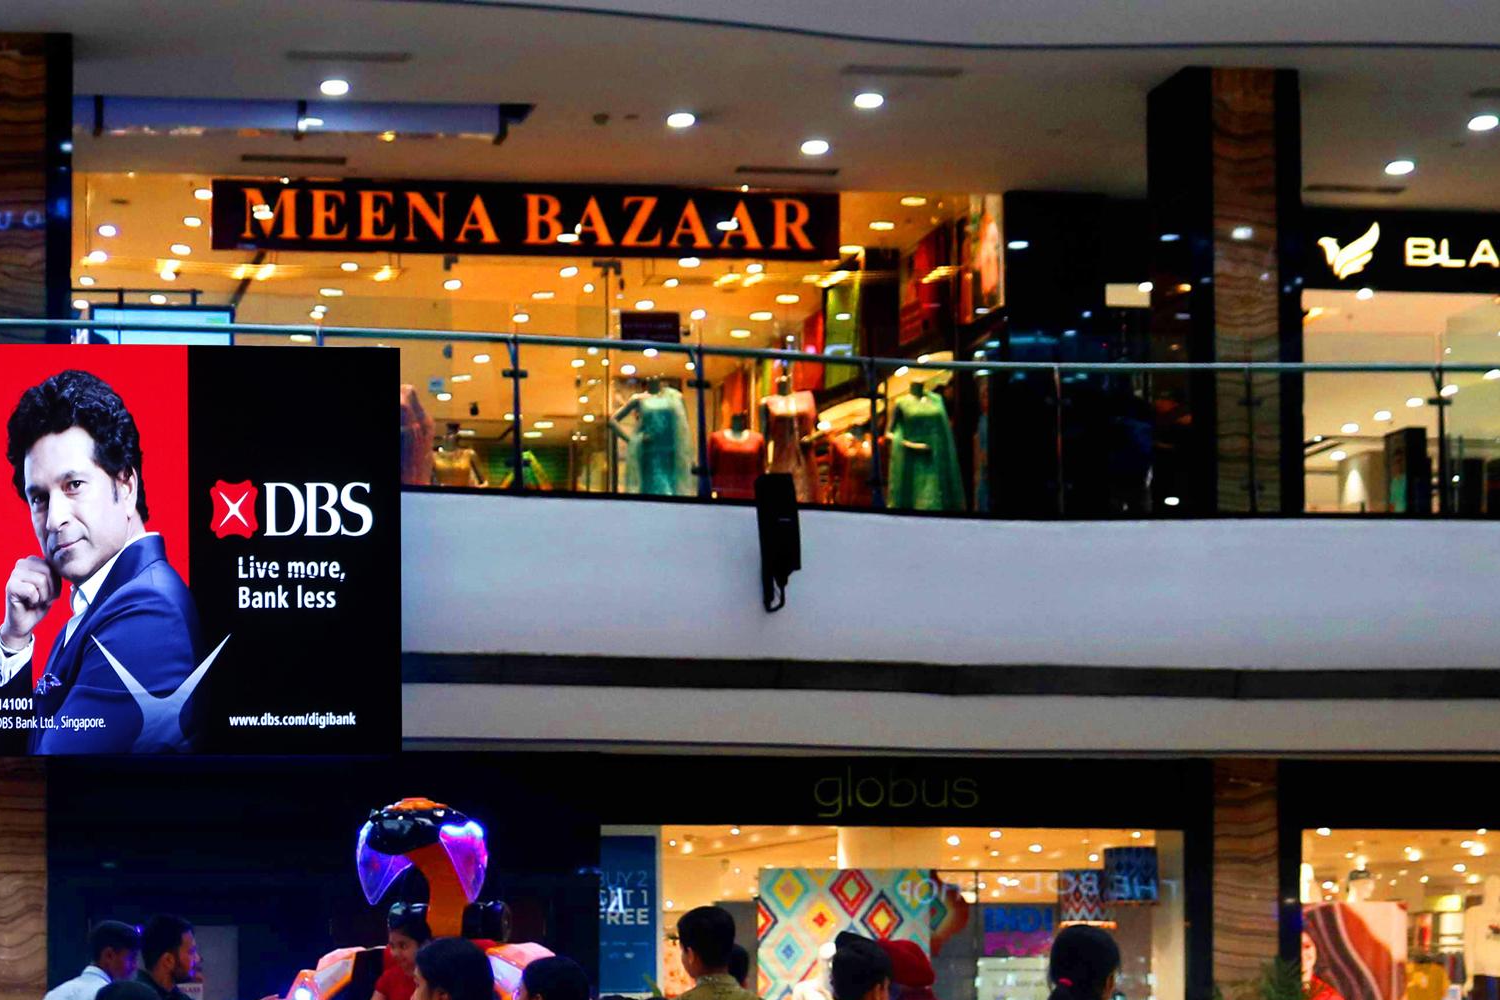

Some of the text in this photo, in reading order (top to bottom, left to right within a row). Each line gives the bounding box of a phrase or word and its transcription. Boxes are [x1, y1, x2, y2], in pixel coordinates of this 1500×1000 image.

[241, 188, 814, 250] MEENA BAZAAR
[1405, 237, 1500, 268] BLA
[263, 482, 373, 537] DBS
[238, 555, 346, 582] Live more,
[238, 585, 337, 609] Bank less
[16, 716, 38, 729] Bank
[40, 716, 59, 731] Ltd.,
[61, 715, 106, 732] Singapore.
[229, 712, 356, 729] www.dbs.com/digibank
[814, 764, 980, 818] globus
